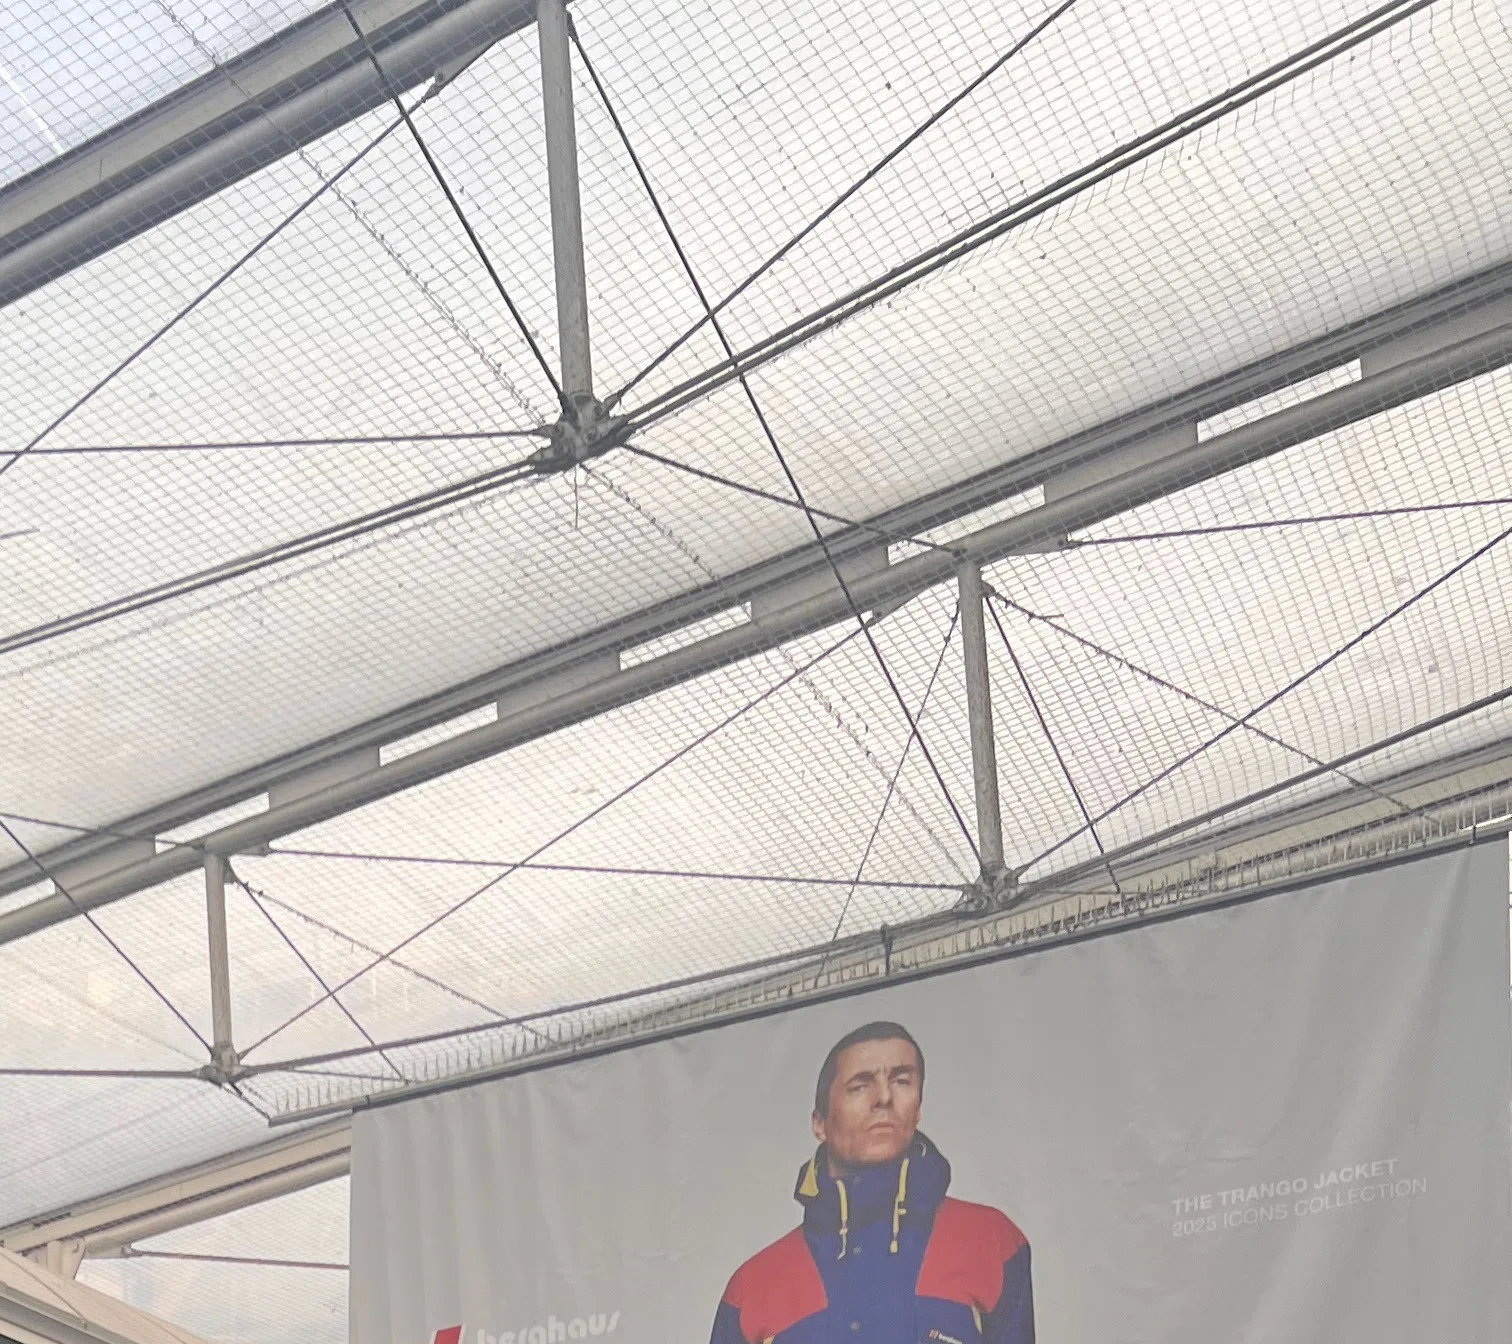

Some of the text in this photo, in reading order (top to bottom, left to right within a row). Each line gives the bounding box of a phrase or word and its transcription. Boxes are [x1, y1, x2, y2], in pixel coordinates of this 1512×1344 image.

[1172, 1158, 1398, 1217] THE TRANGO JACKET
[1172, 1177, 1428, 1238] 2025 ICONS COLLECTION
